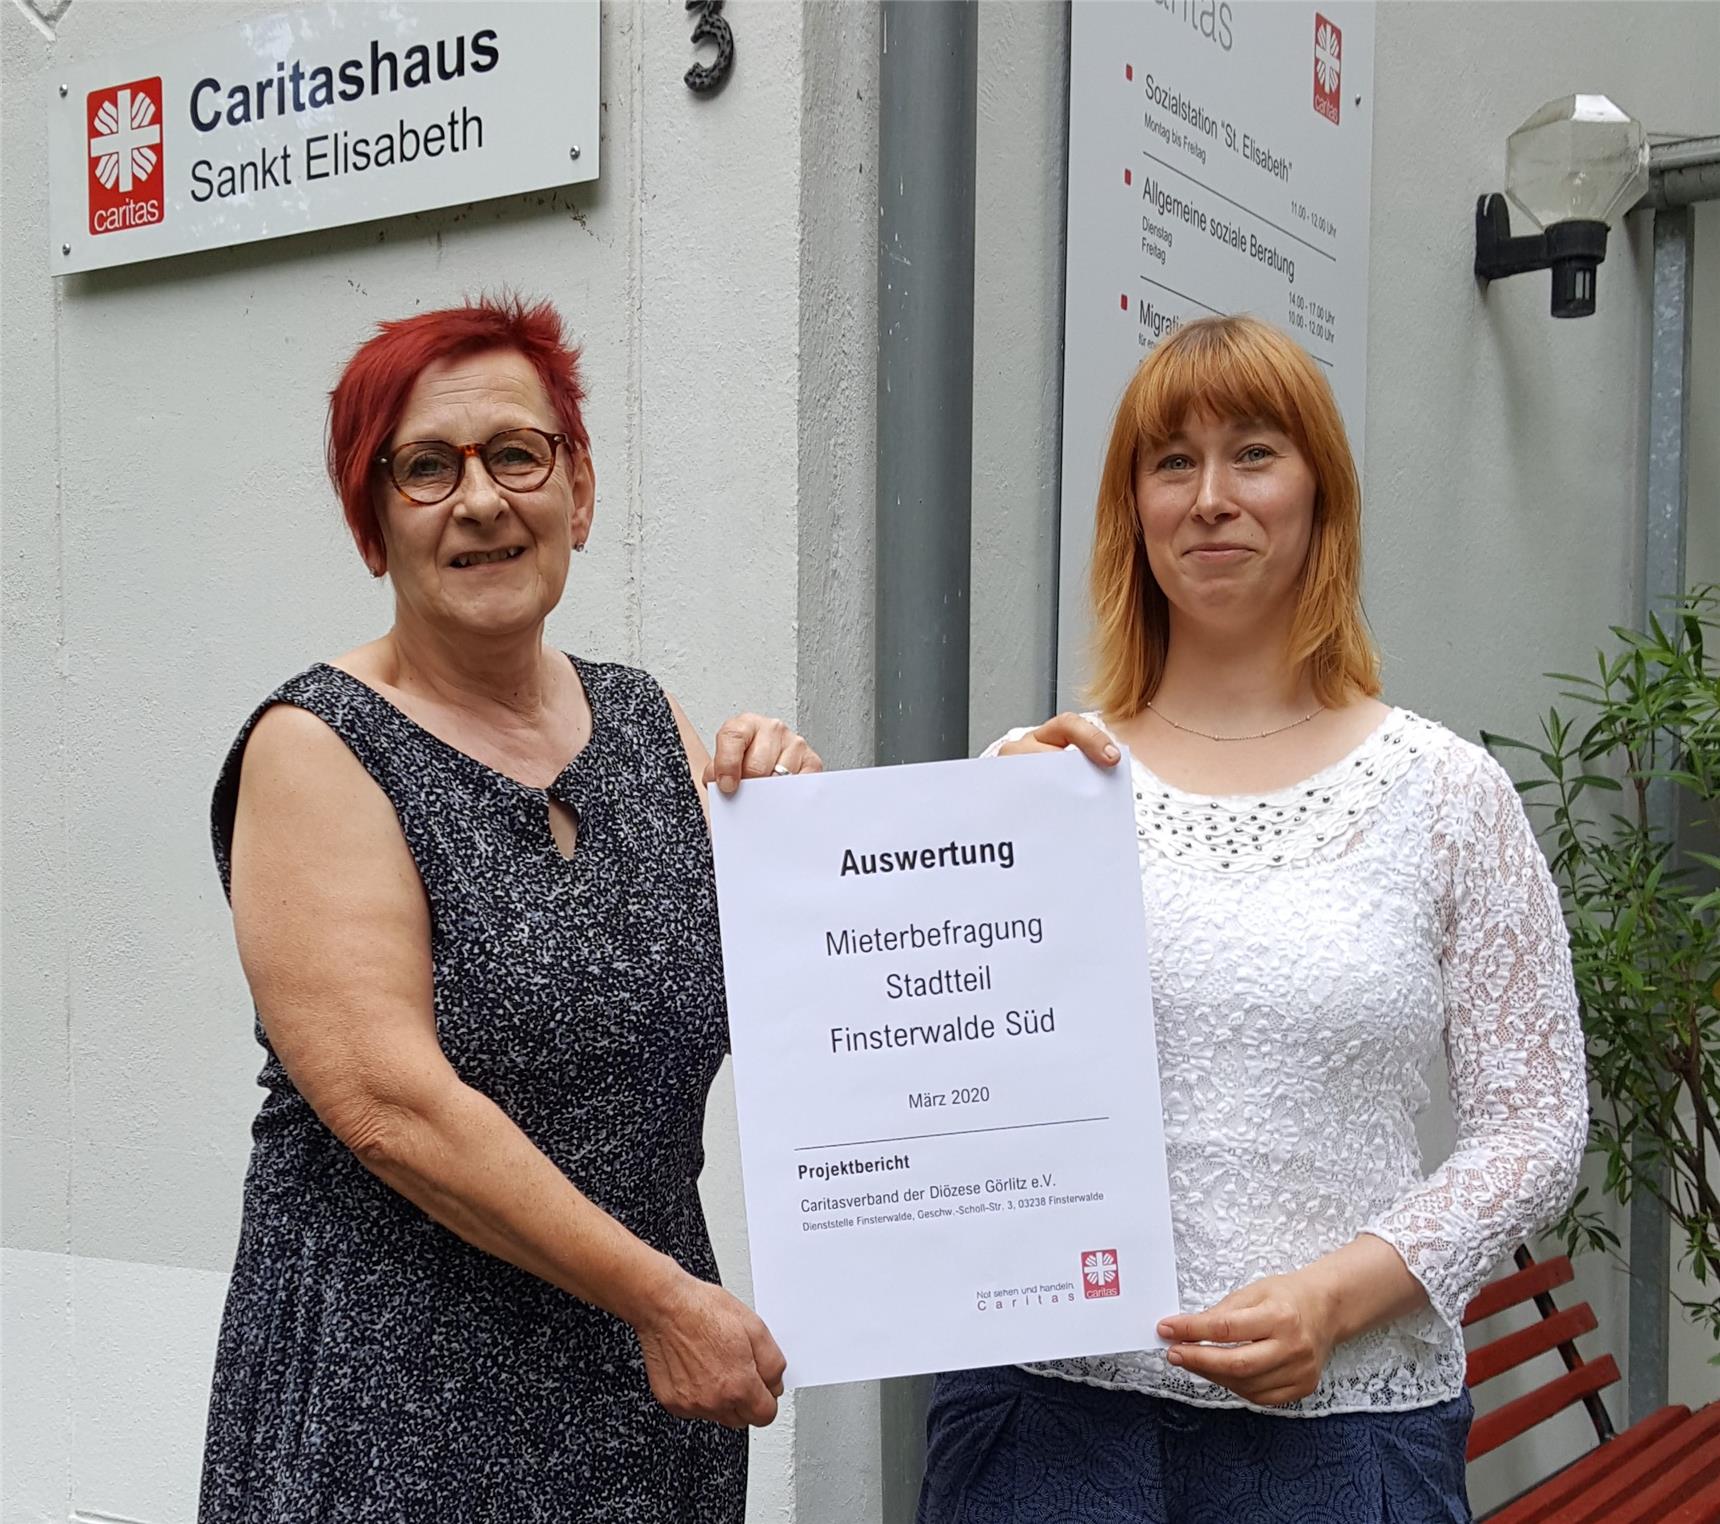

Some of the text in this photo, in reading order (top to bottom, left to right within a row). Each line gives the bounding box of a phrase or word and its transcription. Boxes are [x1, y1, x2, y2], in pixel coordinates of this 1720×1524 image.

[189, 27, 500, 132] Caritashaus
[1145, 74, 1217, 139] Sozialstation
[190, 107, 484, 202] Sankt Elisabeth
[1144, 112, 1207, 165] Montag bis Freitag
[94, 198, 159, 232] caritas
[1142, 216, 1173, 248] Dienstag
[1143, 177, 1295, 283] Allgemeine soziale Beratung
[1141, 237, 1166, 265] Freitag
[1325, 309, 1335, 325] Uhr
[1325, 328, 1334, 343] Uhr
[840, 840, 1014, 876] Auswertung
[825, 915, 1043, 956] Mieterbefragung
[886, 965, 992, 999] Stadtteil
[830, 1007, 1055, 1053] Finsterwalde Süd
[908, 1086, 990, 1109] März 2020
[798, 1155, 911, 1181] Projektbericht
[801, 1173, 1056, 1213] Caritasverband der Diözese Görlitz e.V.
[802, 1217, 854, 1231] Dienststelle
[856, 1211, 915, 1226] Finsterwalde,
[1018, 1197, 1046, 1208] 03238
[1049, 1192, 1104, 1205] Finsterwalde
[976, 1290, 991, 1299] Not
[993, 1287, 1019, 1297] sehen
[1021, 1284, 1038, 1295] und
[1086, 1286, 1118, 1298] caritas
